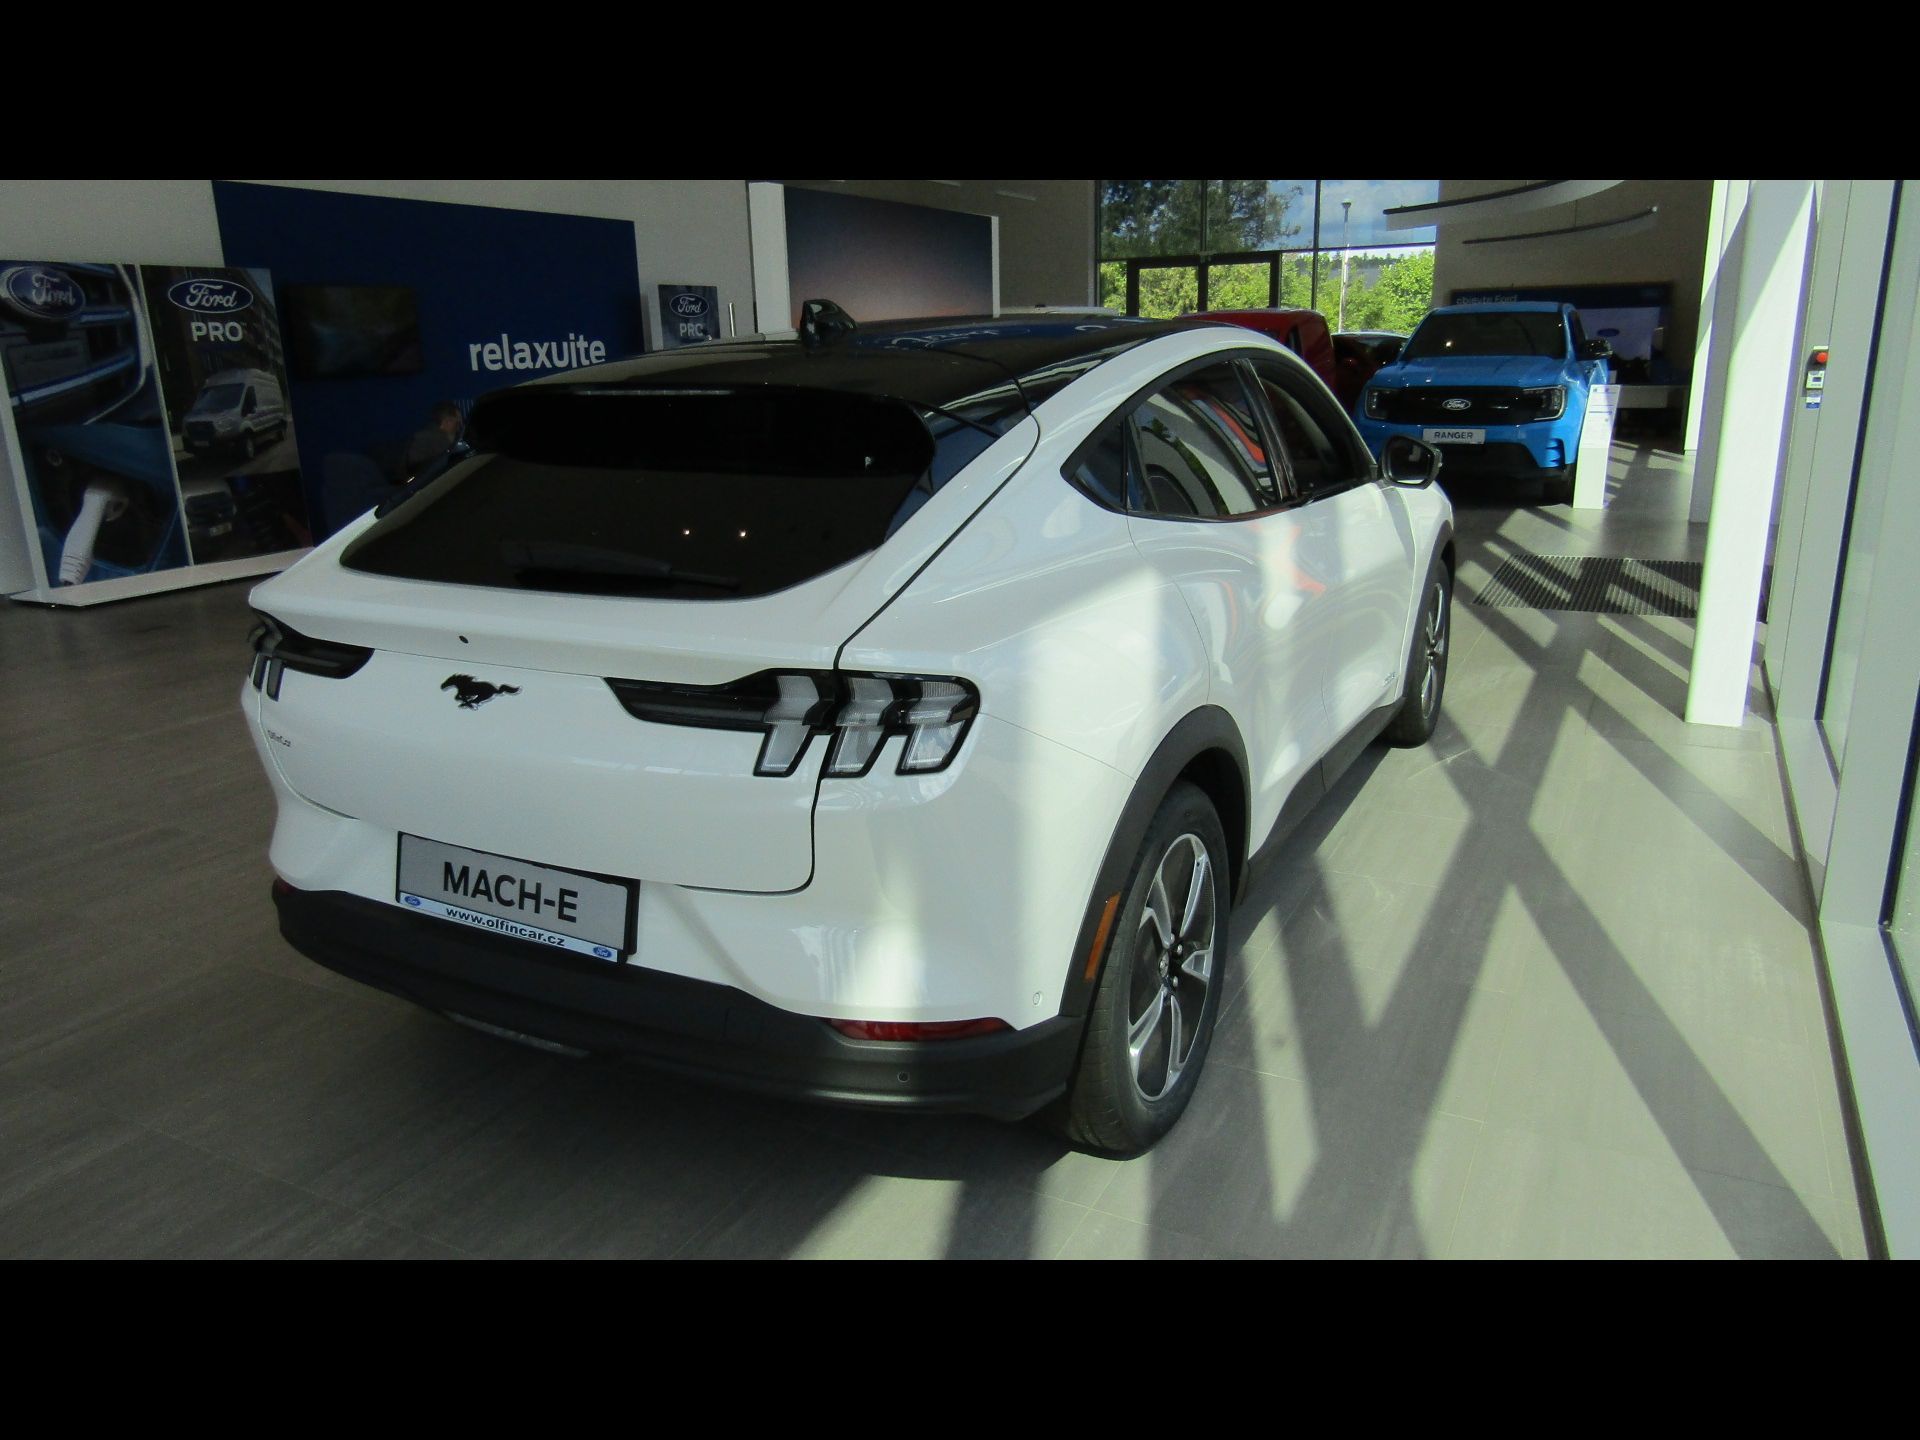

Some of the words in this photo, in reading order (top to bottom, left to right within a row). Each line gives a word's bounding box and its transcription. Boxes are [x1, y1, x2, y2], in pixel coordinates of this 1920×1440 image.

[186, 283, 238, 307] Ford
[677, 296, 702, 313] Ford
[191, 321, 243, 342] PRO
[469, 333, 606, 371] relaxuite
[1434, 431, 1474, 440] RANGER
[443, 861, 579, 924] MACH-E
[446, 907, 565, 947] www.olfincar.cz
